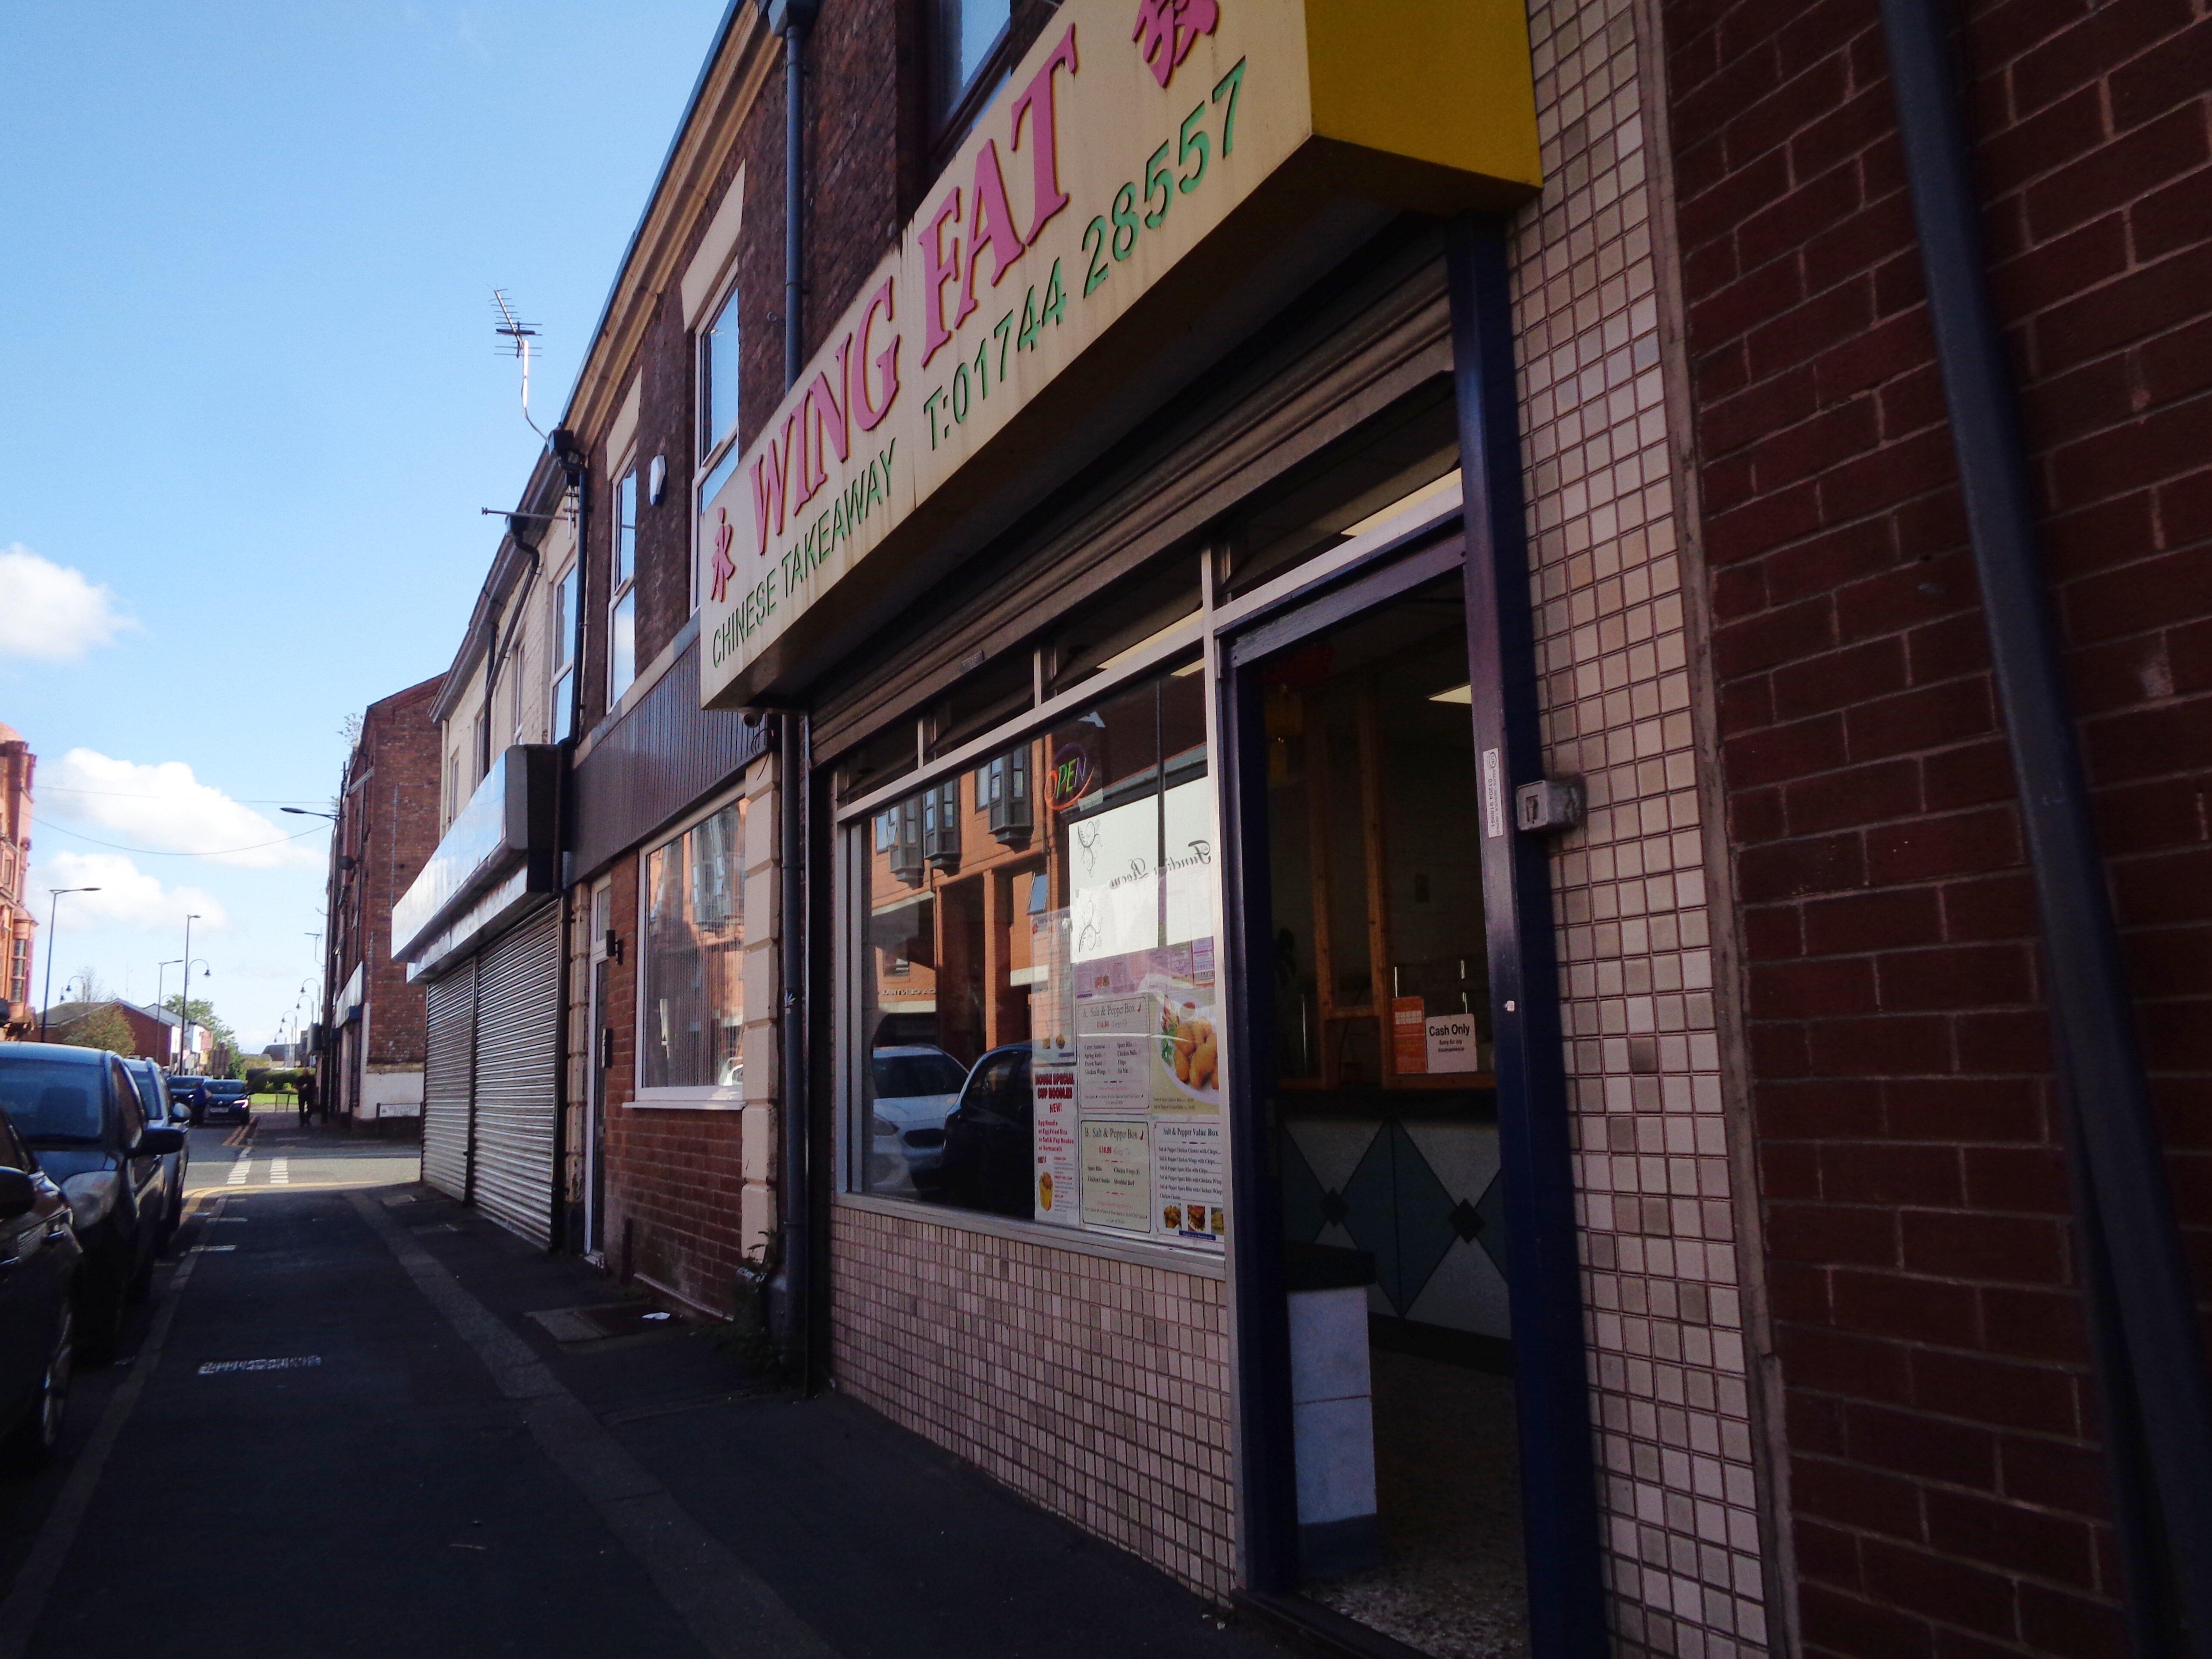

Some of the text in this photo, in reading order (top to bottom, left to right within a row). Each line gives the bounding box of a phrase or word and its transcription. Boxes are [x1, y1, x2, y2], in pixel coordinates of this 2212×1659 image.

[1082, 55, 1247, 298] 28557
[749, 22, 1078, 556] WING FAT
[713, 437, 896, 668] CHINESE TAKEAWAY
[1044, 757, 1086, 805] OPEN
[1090, 1006, 1100, 1017] Salt
[1101, 1005, 1106, 1015] &
[1107, 1005, 1124, 1017] Pepper
[1125, 1003, 1135, 1014] Box
[1429, 1024, 1470, 1036] Cash Only
[1050, 1103, 1062, 1113] NEW!
[1093, 1128, 1102, 1137] Salt
[1103, 1128, 1108, 1137] &
[1110, 1128, 1126, 1141] Pepper
[1128, 1128, 1137, 1139] Box
[1177, 1128, 1192, 1137] Pepper
[1193, 1128, 1207, 1136] Value
